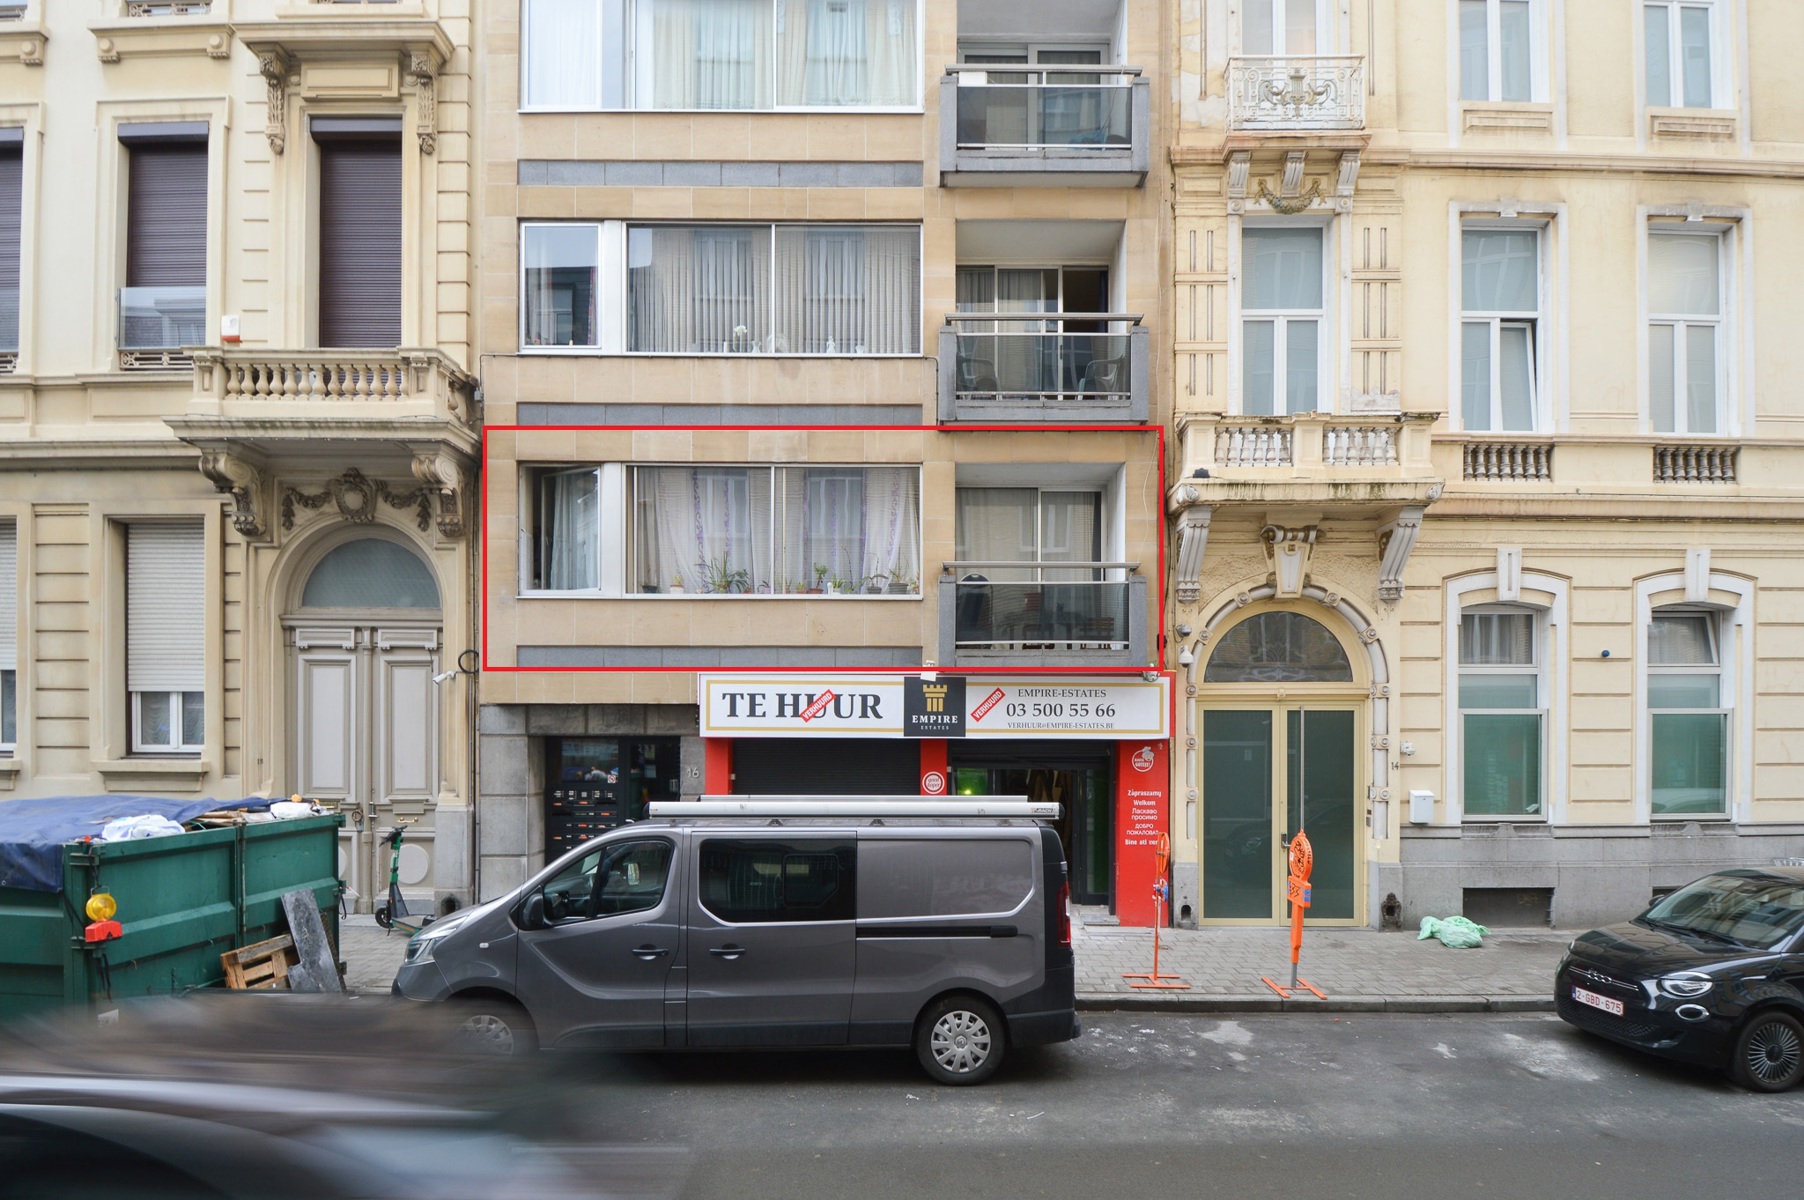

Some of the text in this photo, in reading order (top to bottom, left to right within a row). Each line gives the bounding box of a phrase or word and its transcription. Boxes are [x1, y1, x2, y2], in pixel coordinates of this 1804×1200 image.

[1018, 689, 1107, 698] EMPIRE-ESTATES
[722, 693, 883, 719] TE HUUR
[803, 693, 831, 719] VERHUURD
[973, 692, 1001, 718] VERHUURD
[1006, 703, 1116, 717] 03 500 55 66
[911, 715, 958, 724] EMPIRE
[687, 766, 699, 778] 16
[1391, 761, 1399, 770] 14
